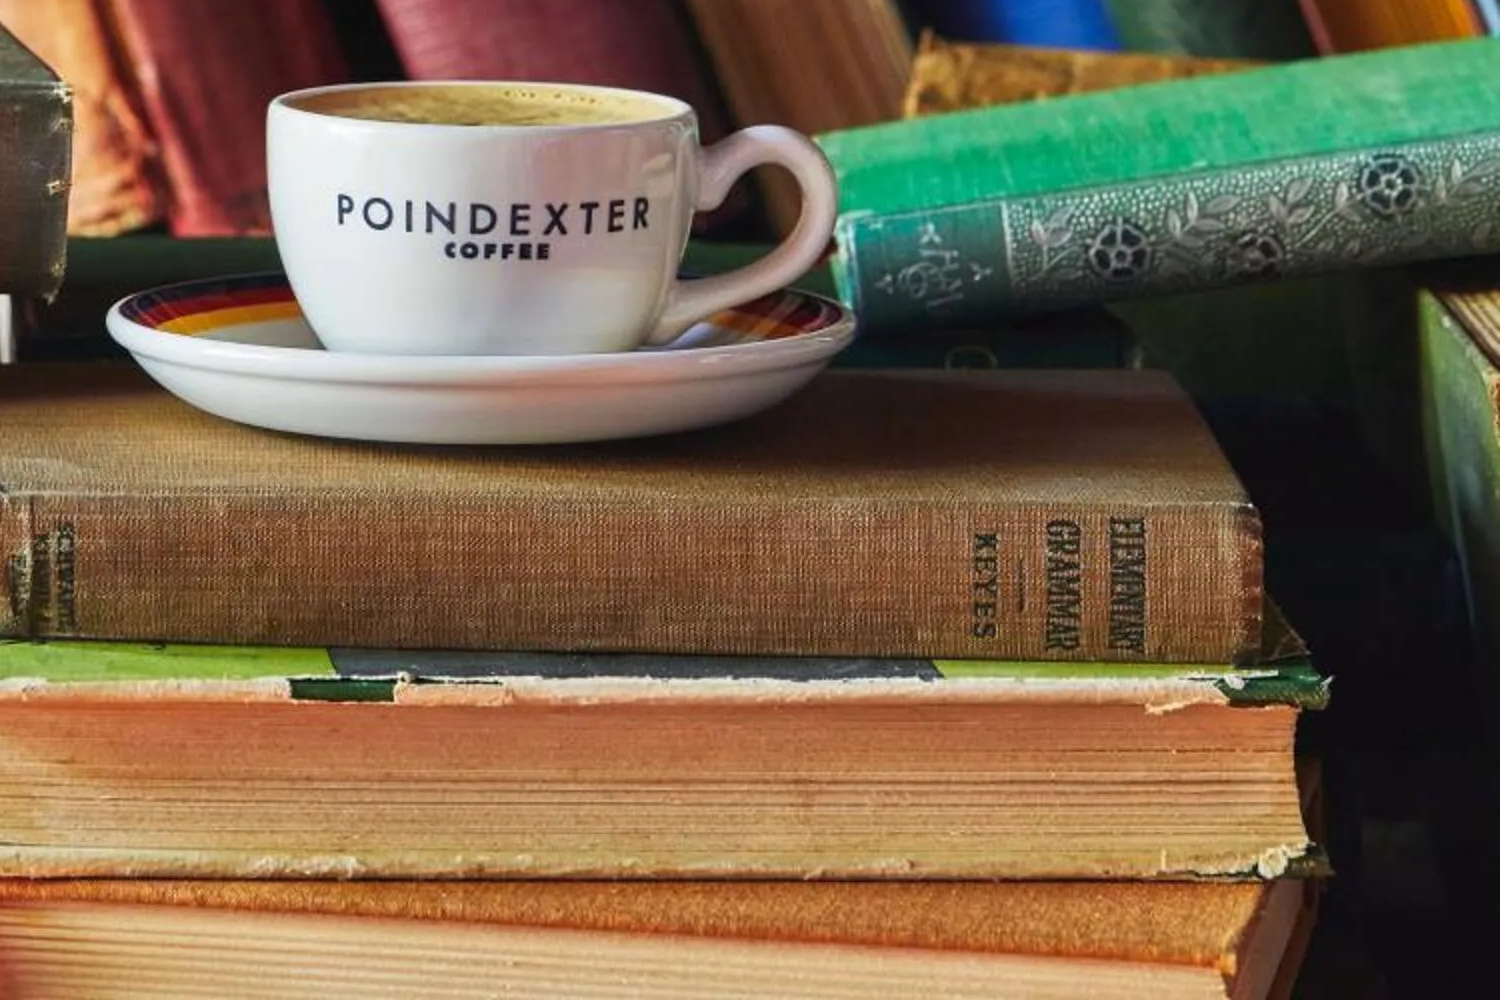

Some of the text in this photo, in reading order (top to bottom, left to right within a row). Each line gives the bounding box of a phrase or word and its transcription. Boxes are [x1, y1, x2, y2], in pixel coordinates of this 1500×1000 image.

[336, 194, 650, 236] POINDEXTER
[444, 242, 551, 260] COFFEE
[973, 533, 998, 638] KEYES
[1046, 518, 1081, 651] GRAMMAR
